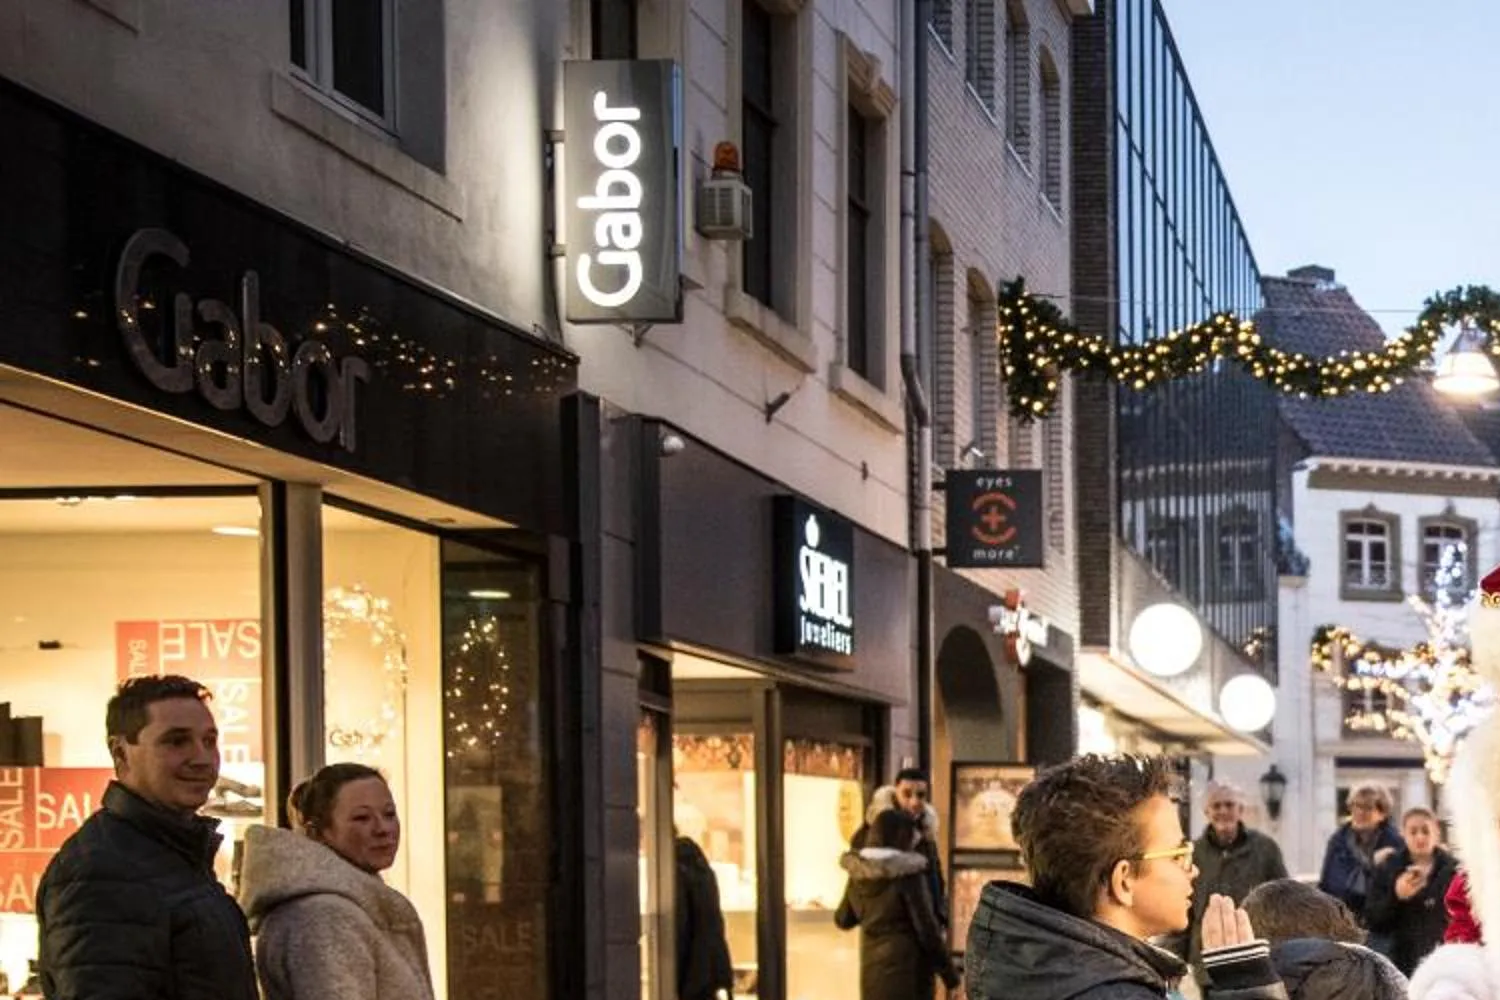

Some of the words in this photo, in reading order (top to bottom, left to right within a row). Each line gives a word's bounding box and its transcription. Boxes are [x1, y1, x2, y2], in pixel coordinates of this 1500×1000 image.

[577, 91, 642, 306] Gabor
[115, 228, 371, 453] Gabor
[975, 476, 1012, 490] eyes
[973, 549, 1015, 561] more
[159, 621, 262, 660] SALE
